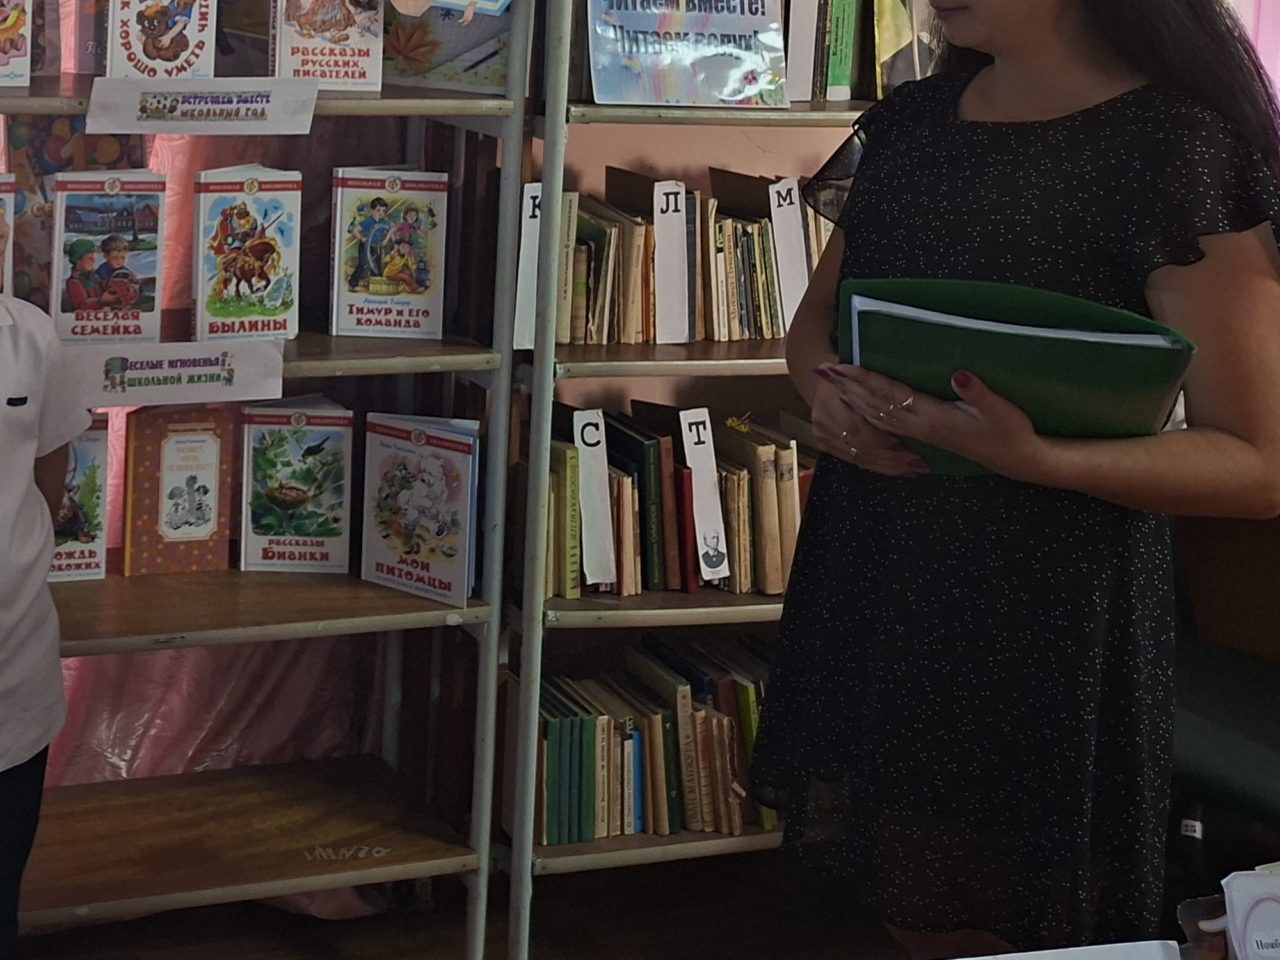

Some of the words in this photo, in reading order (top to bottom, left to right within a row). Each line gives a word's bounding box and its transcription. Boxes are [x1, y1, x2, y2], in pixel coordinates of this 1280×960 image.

[290, 46, 371, 59] РАССКАЗЫ
[300, 58, 360, 69] РУССКИХ
[292, 66, 367, 80] ПИСАТЕЛЕЙ
[660, 191, 682, 215] Л
[775, 187, 796, 209] М
[346, 304, 393, 316] ТИМУР
[407, 308, 430, 318] ЕГО
[71, 322, 142, 336] СЕМЕЙКА
[208, 319, 288, 334] БЫЛИНЫ
[355, 317, 421, 329] КОМАНДА
[580, 422, 602, 447] С
[687, 420, 708, 446] Т
[53, 550, 97, 560] ОЖДЬ
[396, 555, 431, 572] МОИ
[375, 561, 453, 593] ПИТОМЦЫ
